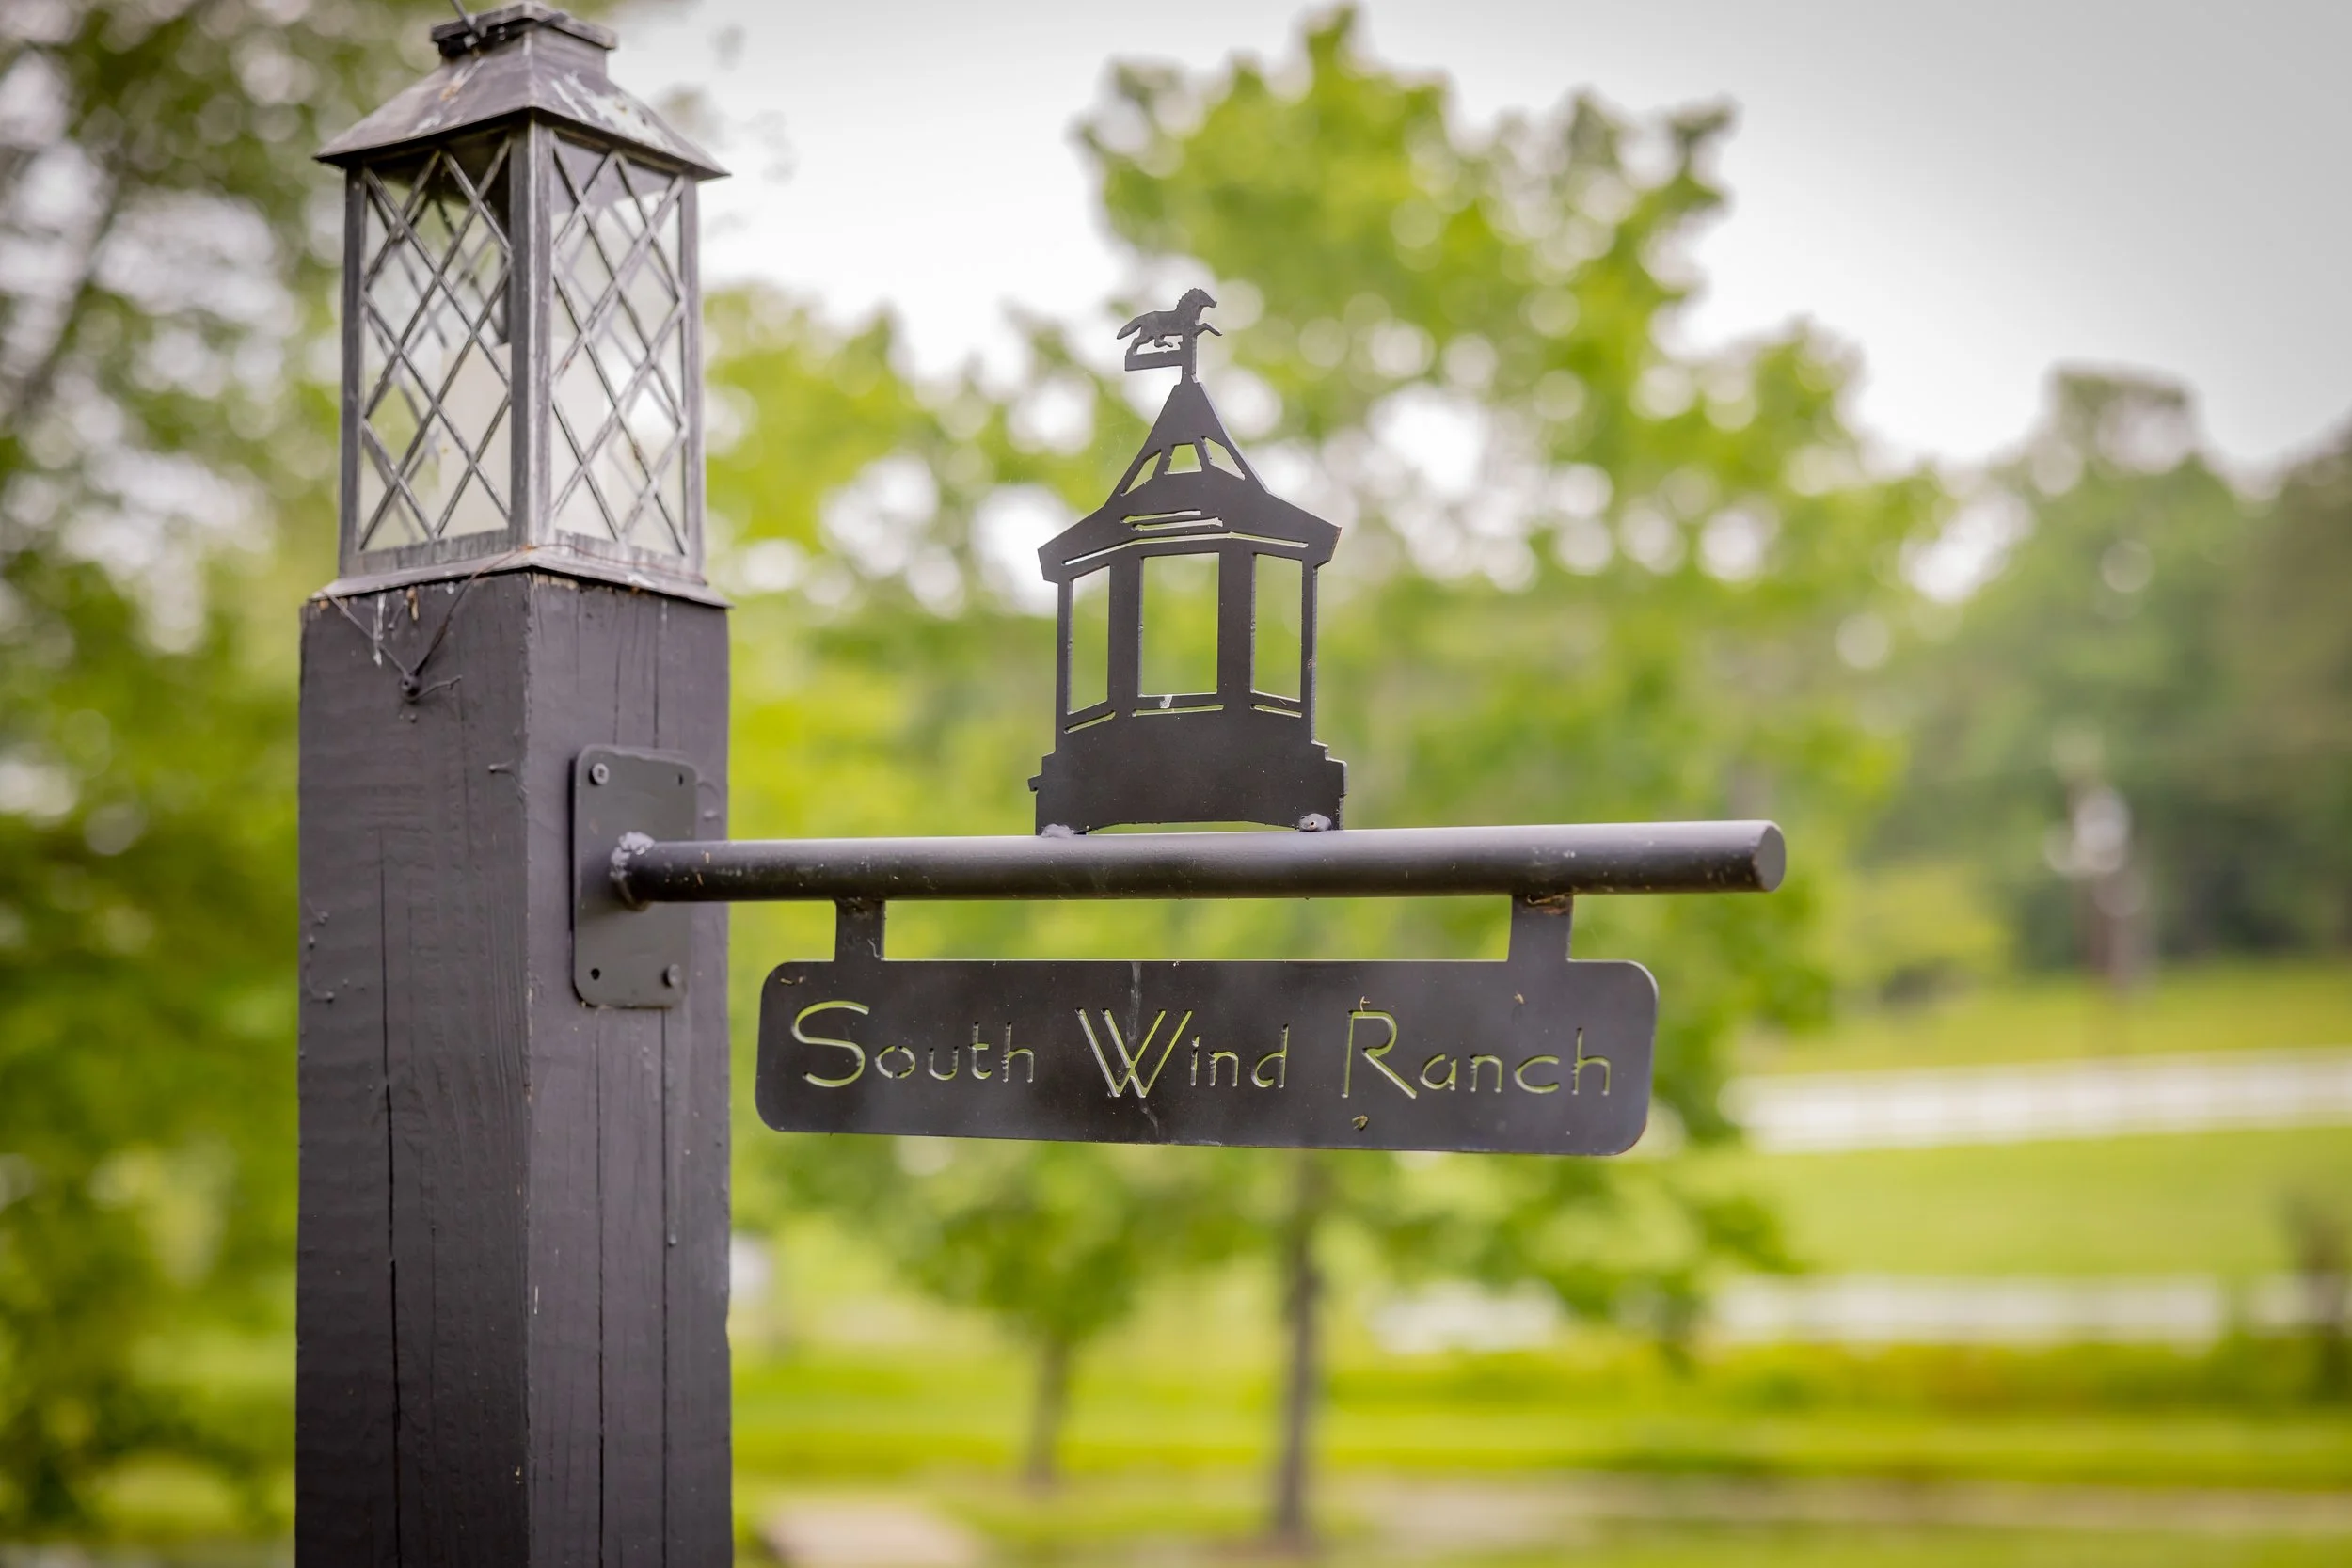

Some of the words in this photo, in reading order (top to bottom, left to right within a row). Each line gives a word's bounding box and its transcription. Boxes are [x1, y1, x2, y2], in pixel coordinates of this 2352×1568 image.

[790, 1000, 1035, 1088] South
[1076, 1008, 1289, 1099] Wind
[1342, 1010, 1611, 1099] Ranch
